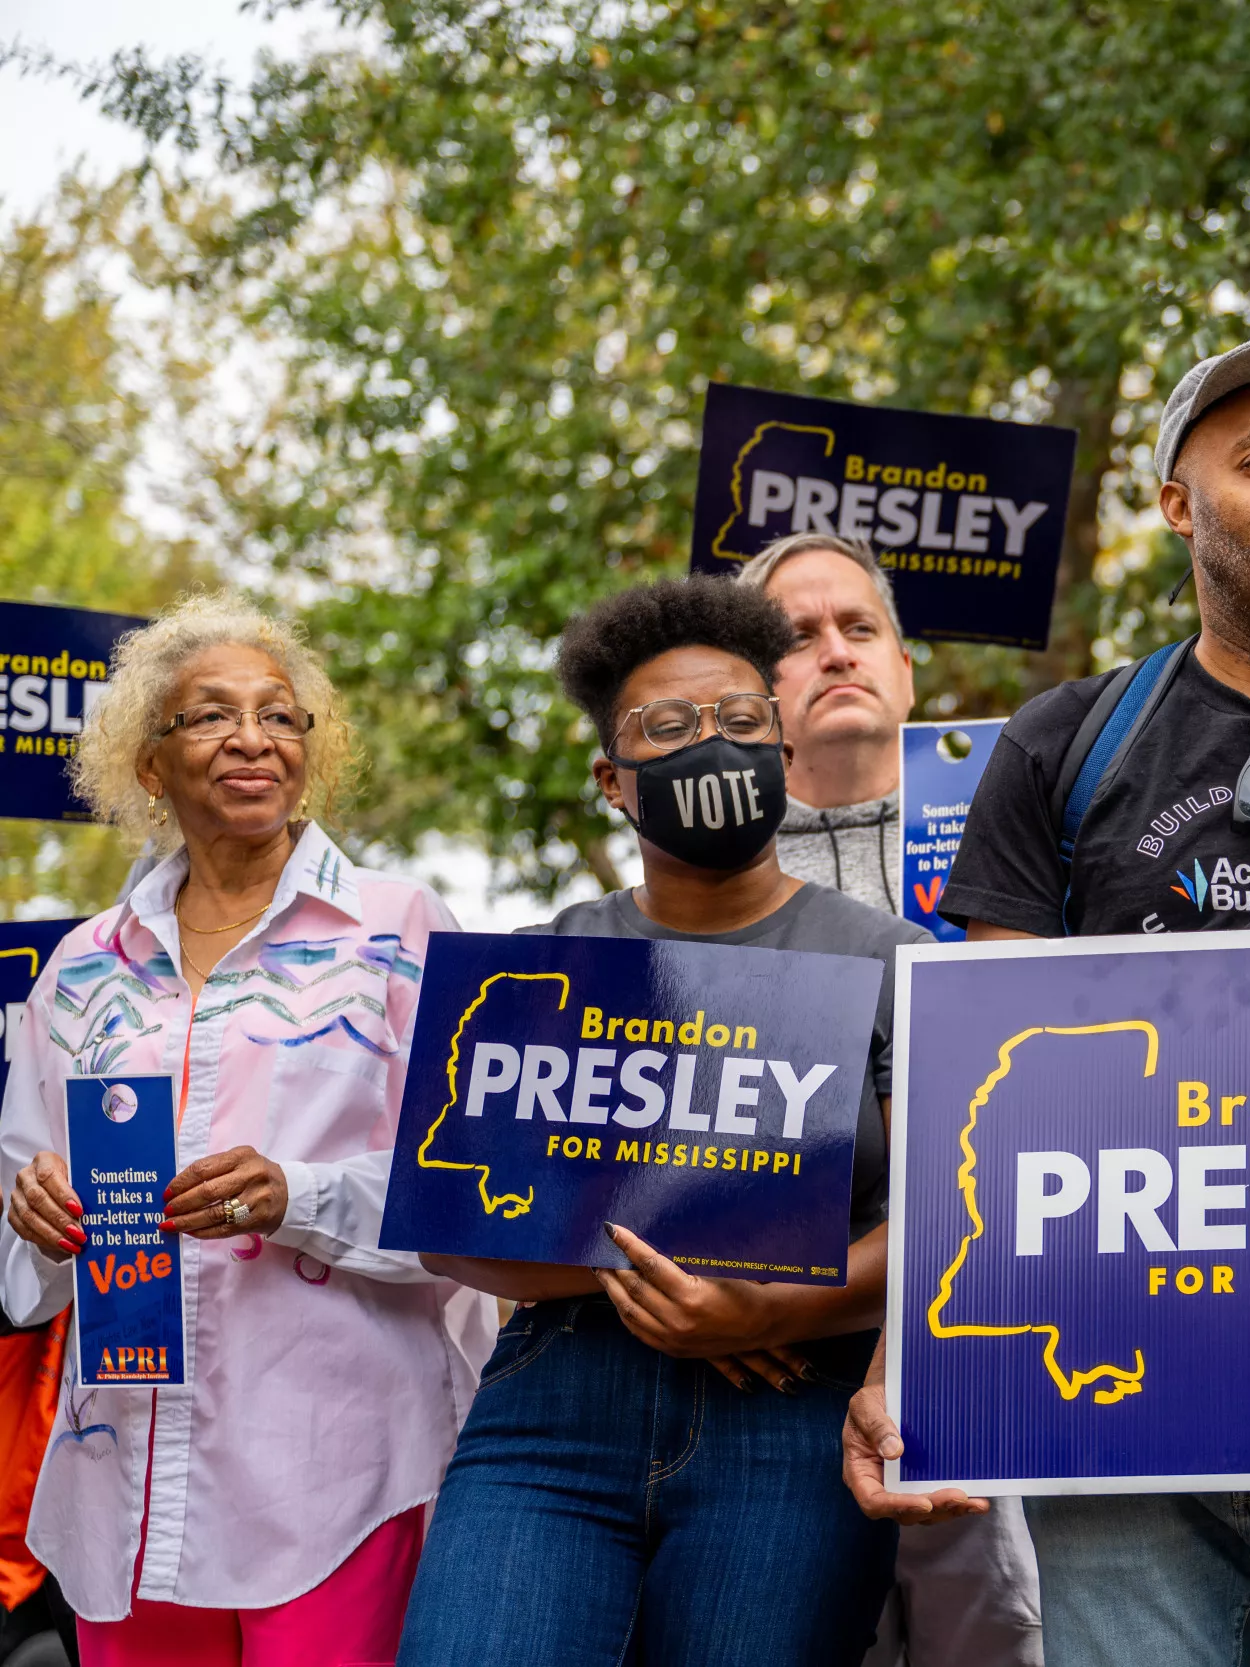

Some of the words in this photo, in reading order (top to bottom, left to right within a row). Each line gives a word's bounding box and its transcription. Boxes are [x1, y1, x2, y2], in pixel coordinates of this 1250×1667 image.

[845, 455, 987, 492] Brandon
[748, 469, 1049, 556] PRESLEY
[880, 552, 1022, 579] MISSISSIPPI
[0, 650, 106, 679] randon
[672, 769, 764, 830] VOTE
[927, 822, 937, 836] it
[940, 820, 966, 835] take
[1137, 786, 1233, 858] BUILD
[906, 839, 960, 855] four-lette
[918, 859, 931, 872] to
[933, 856, 948, 870] be
[581, 1006, 757, 1049] Brandon
[465, 1042, 838, 1139] PRESLEY
[547, 1136, 602, 1160] FOR
[615, 1141, 801, 1175] MISSISSIPPI
[90, 1167, 158, 1184] Sometimes
[97, 1189, 107, 1204] it
[109, 1188, 142, 1204] takes
[146, 1191, 153, 1203] a
[82, 1209, 140, 1226] our-letter
[91, 1233, 103, 1246] to
[106, 1230, 121, 1245] be
[124, 1229, 164, 1245] heard.
[87, 1249, 172, 1295] Vote
[672, 1256, 687, 1264] PAID
[688, 1257, 701, 1265] FOR
[710, 1259, 743, 1268] BRANDON
[743, 1262, 768, 1271] PRESLEY
[768, 1264, 804, 1273] CAMPAIGN
[1149, 1266, 1235, 1295] FOR
[96, 1346, 168, 1373] APRI
